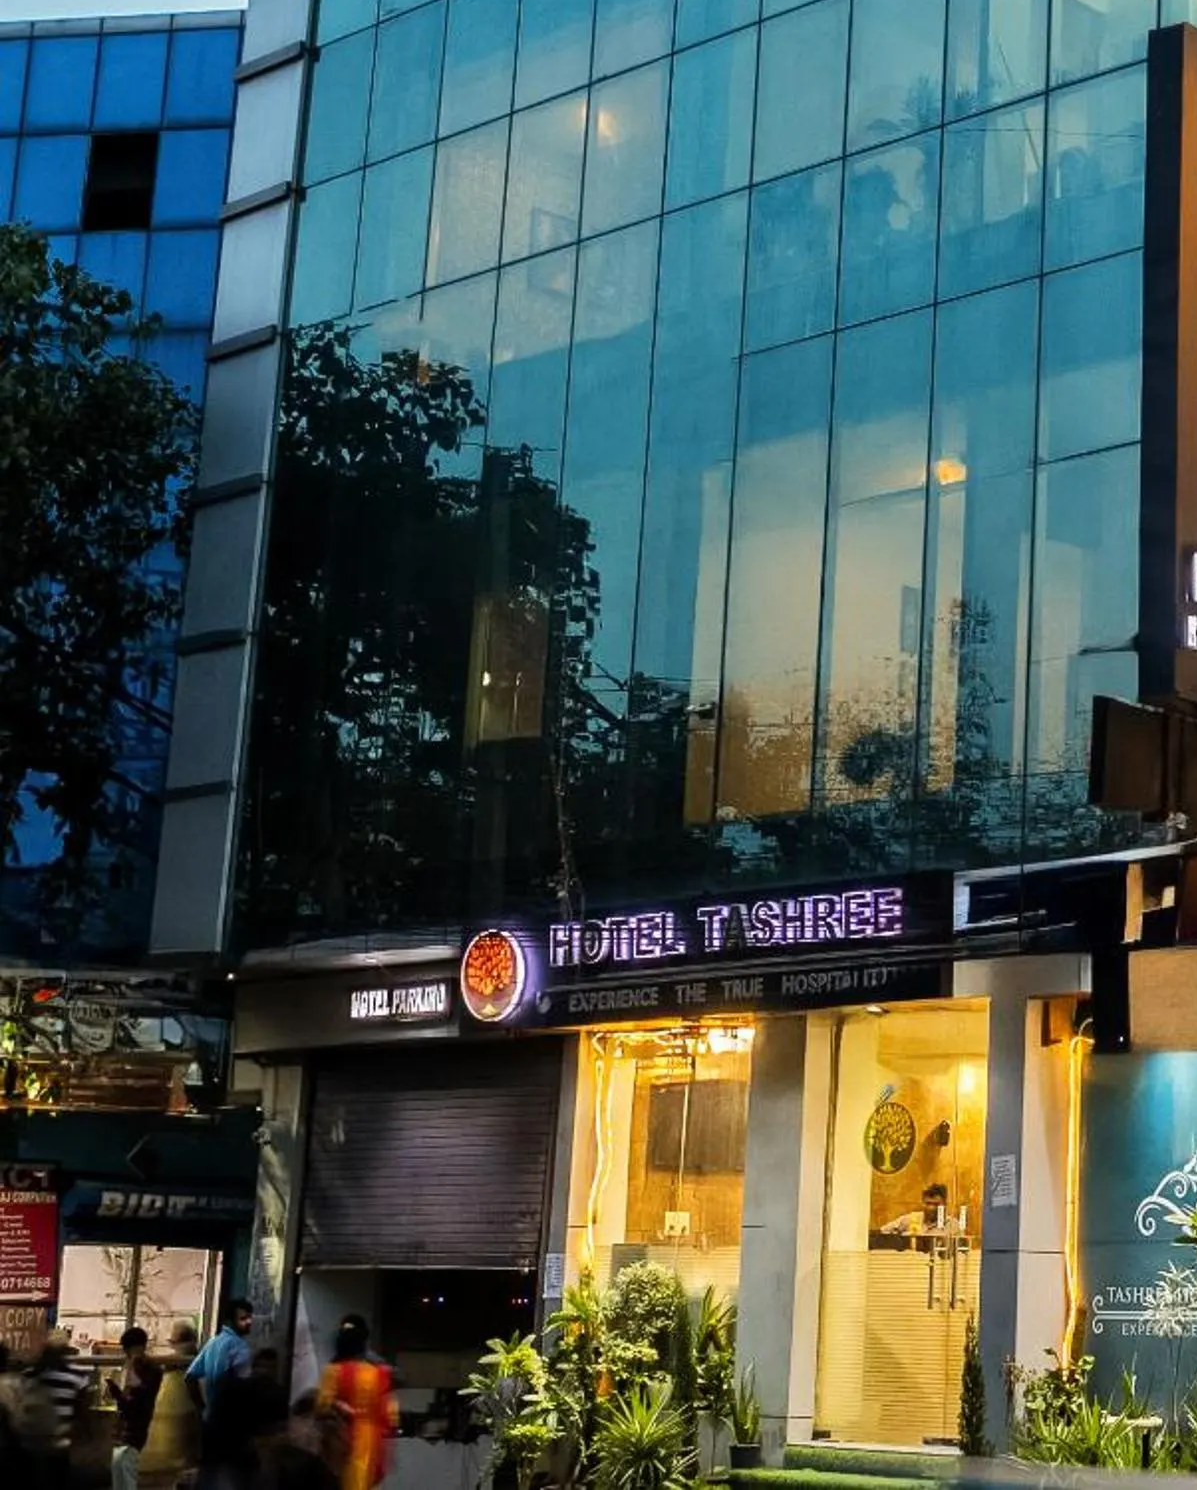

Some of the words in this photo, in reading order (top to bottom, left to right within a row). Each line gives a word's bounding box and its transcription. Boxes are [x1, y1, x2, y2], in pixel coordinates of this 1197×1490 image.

[550, 912, 686, 967] HOTEL
[698, 887, 903, 953] TASHREE
[350, 989, 390, 1018] HOTEL
[391, 982, 446, 1014] PARKING
[568, 987, 659, 1014] EXPERIENCE
[676, 983, 706, 1006] THE
[721, 977, 764, 1000] TRUE
[6, 1307, 44, 1328] COPY
